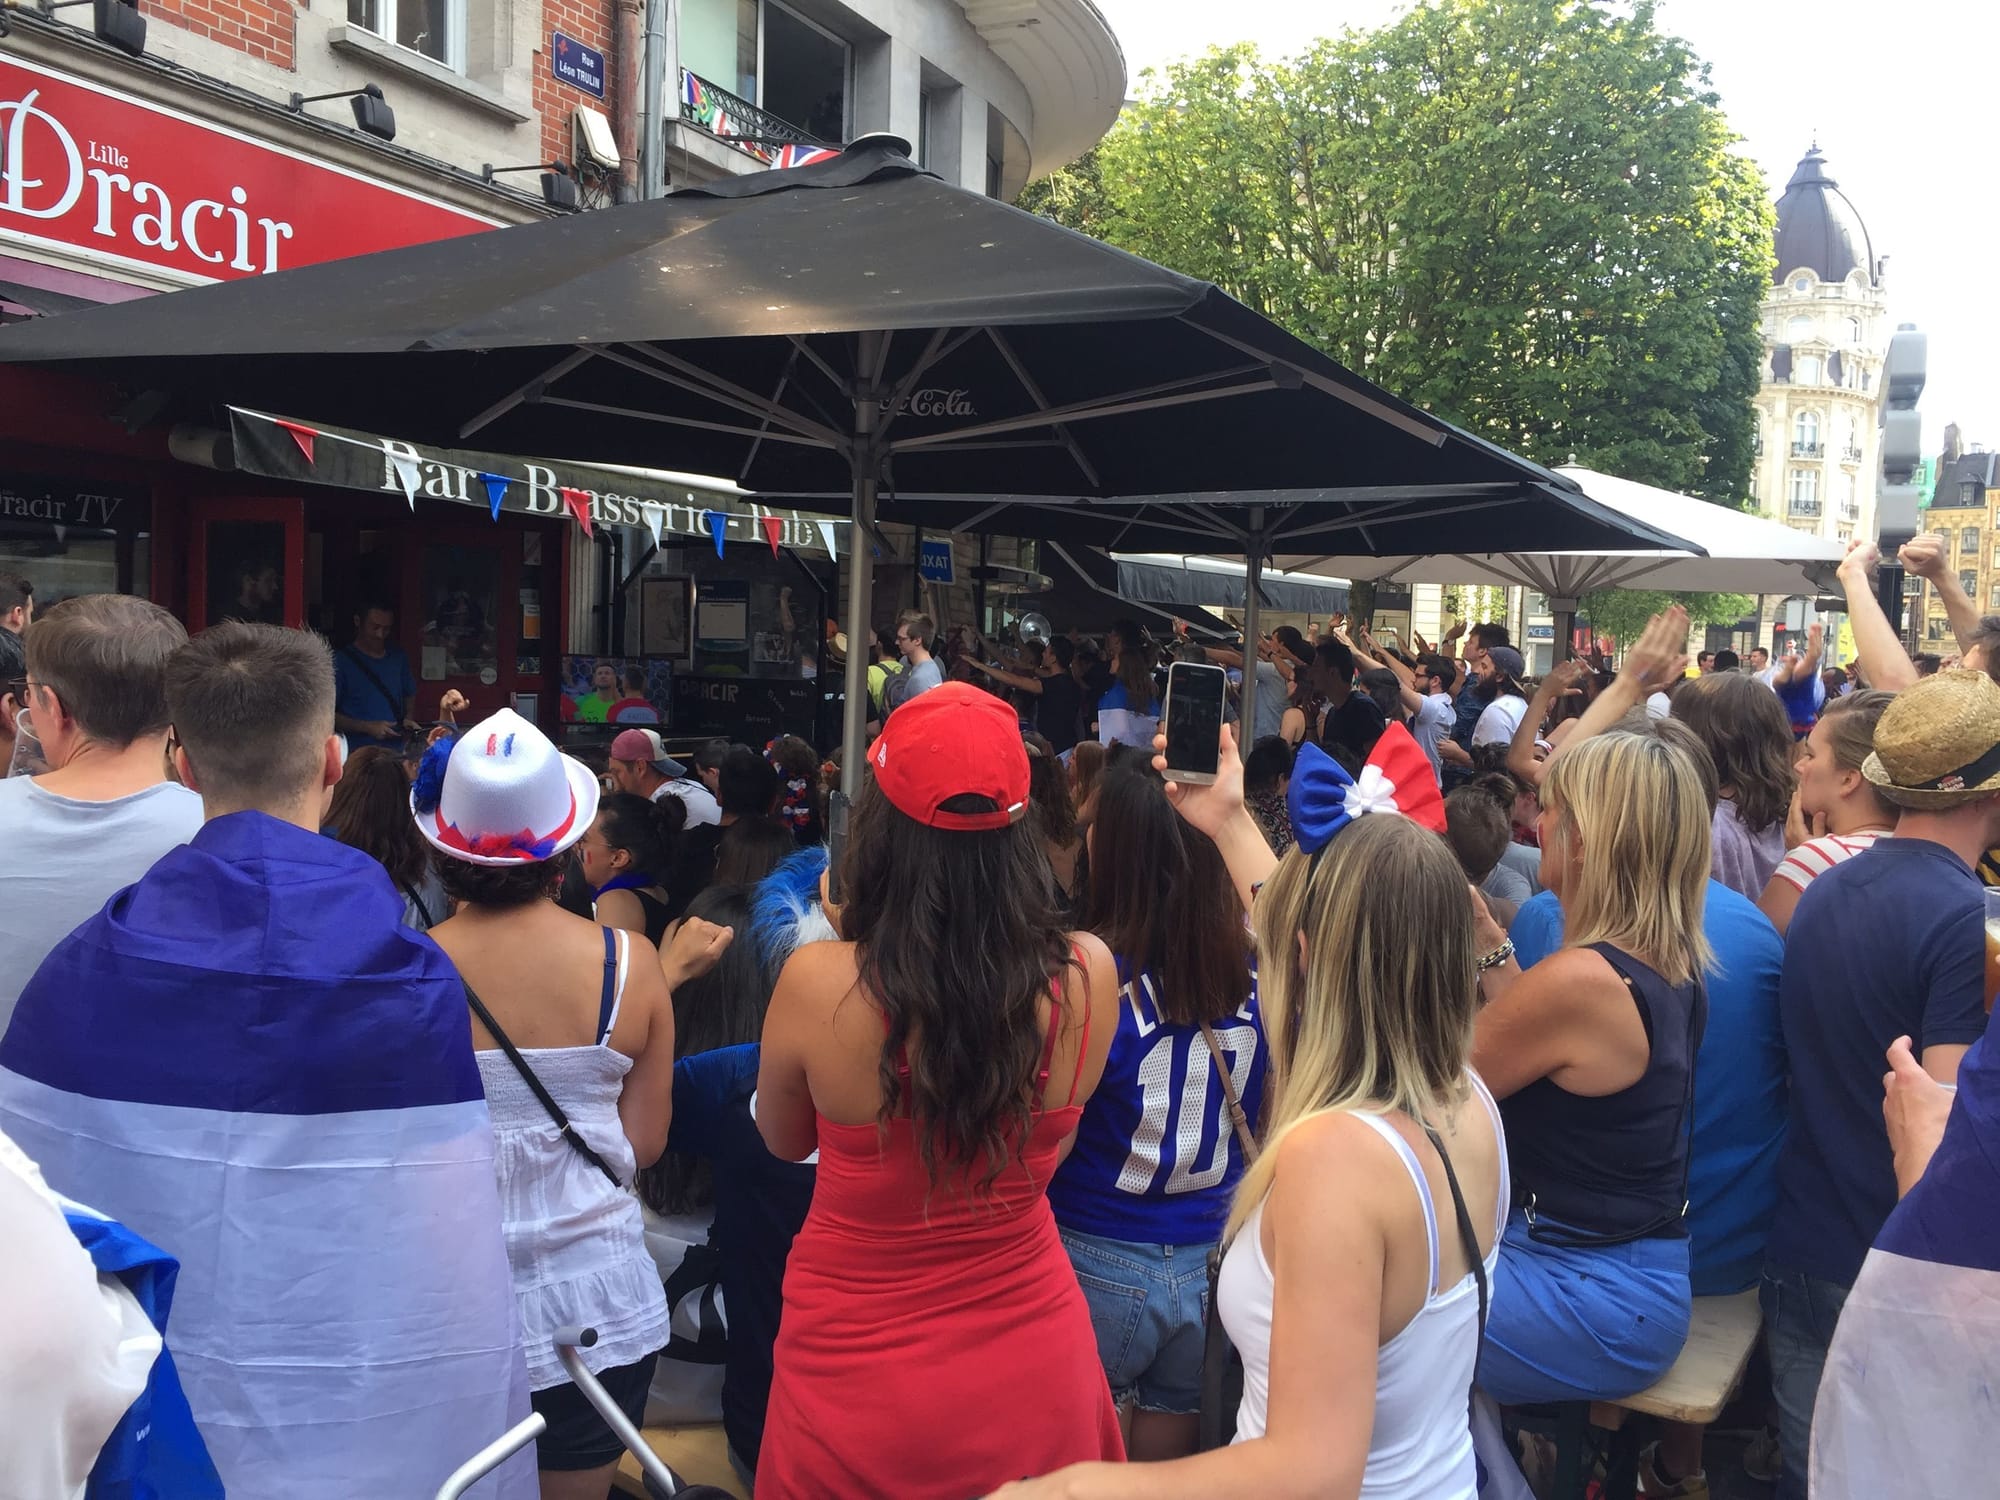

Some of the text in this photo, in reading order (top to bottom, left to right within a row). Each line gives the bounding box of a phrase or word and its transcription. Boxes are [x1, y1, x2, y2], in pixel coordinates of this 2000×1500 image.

[581, 52, 594, 68] Rue
[576, 68, 600, 89] TRULIN
[88, 140, 129, 169] Lille
[377, 438, 478, 502] Bar
[0, 493, 123, 525] racir TV
[1115, 1024, 1259, 1195] 10
